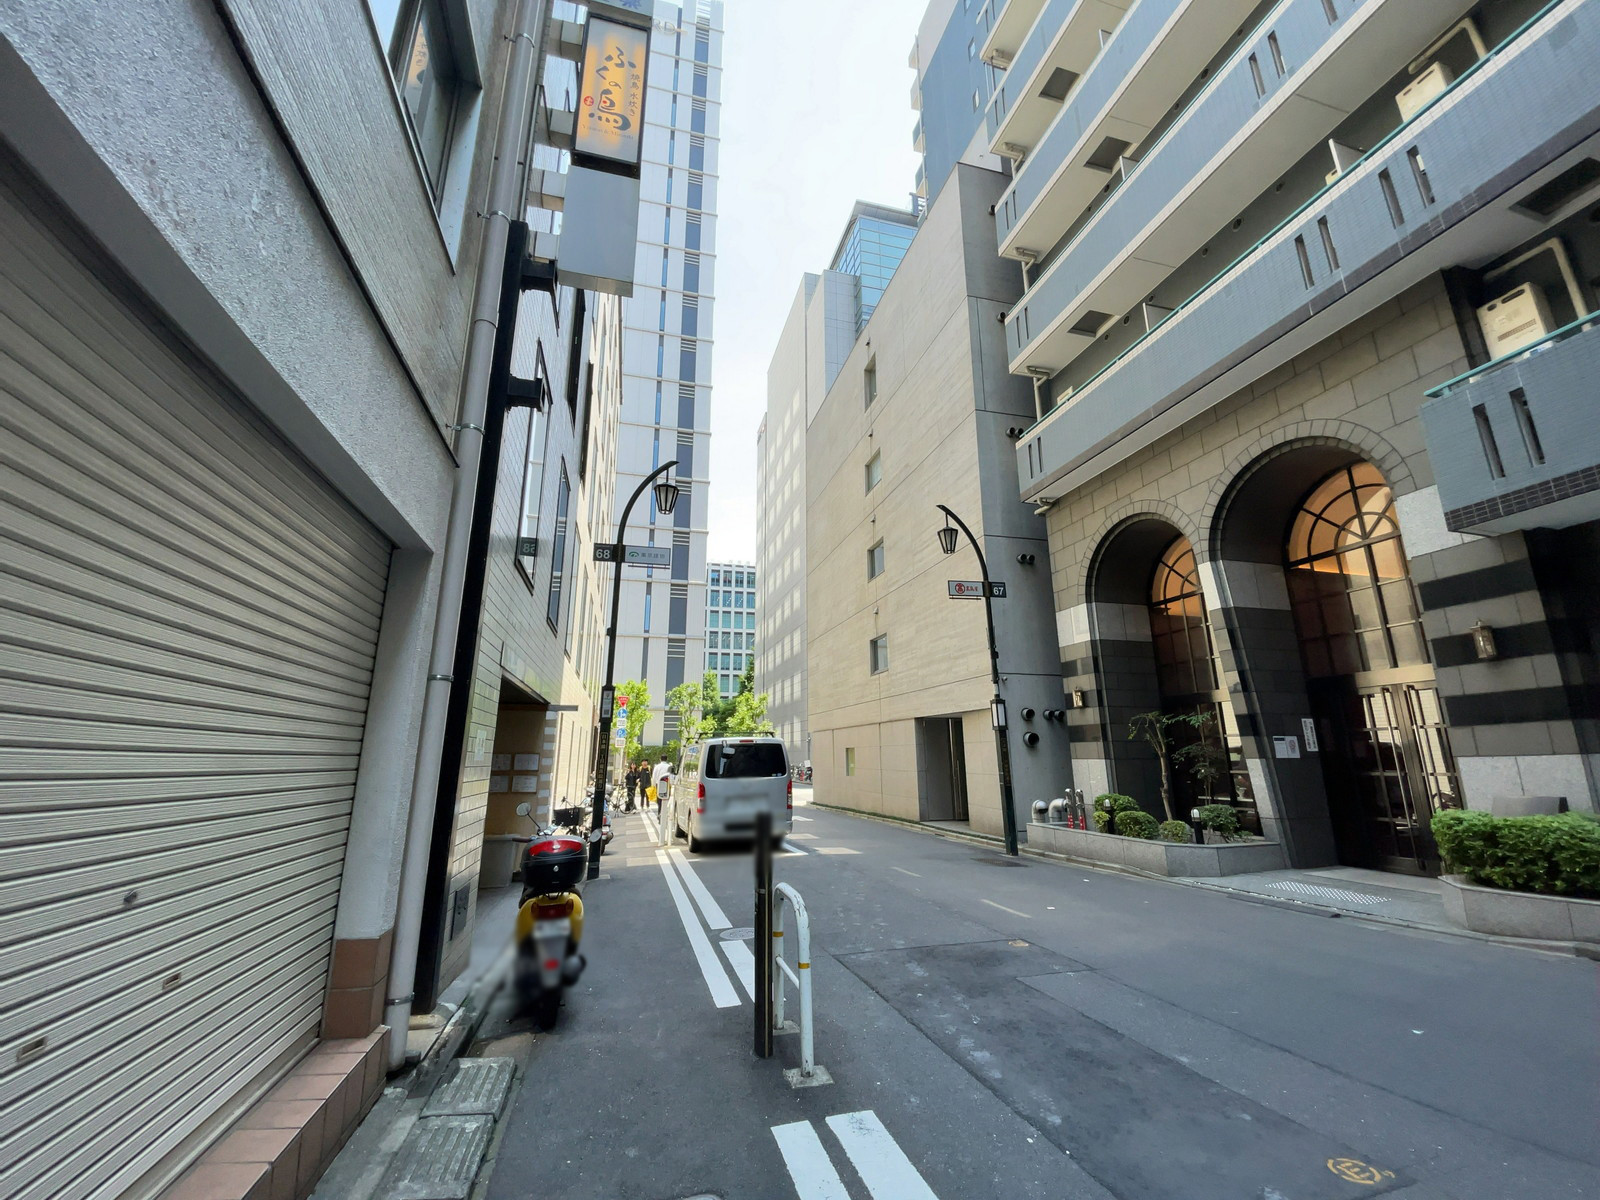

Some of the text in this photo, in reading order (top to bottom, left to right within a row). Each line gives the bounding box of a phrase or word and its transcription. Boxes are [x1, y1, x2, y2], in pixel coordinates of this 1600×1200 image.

[588, 46, 637, 131] ふくの鳥
[595, 548, 611, 560] 68
[993, 586, 1004, 596] 67
